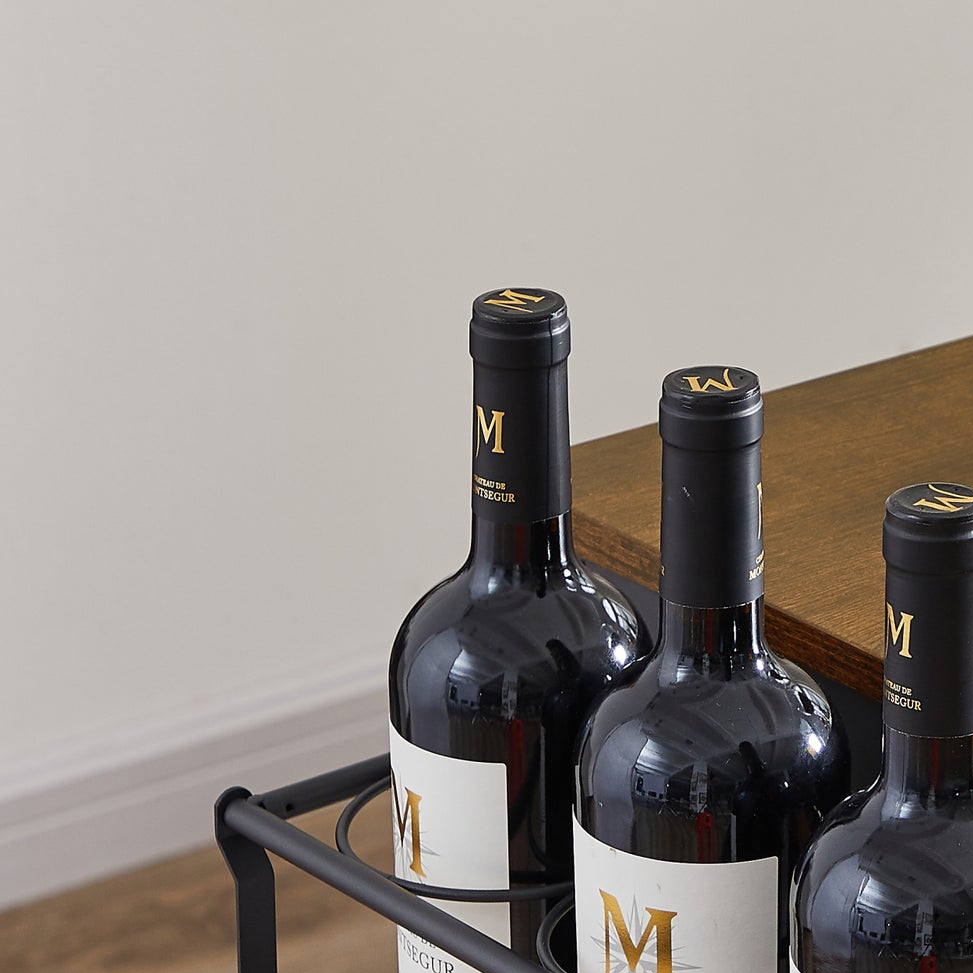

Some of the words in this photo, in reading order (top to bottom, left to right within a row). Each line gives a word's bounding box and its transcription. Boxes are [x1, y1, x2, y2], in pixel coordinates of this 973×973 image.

[483, 289, 546, 313] M
[476, 404, 505, 459] M
[885, 602, 914, 658] M
